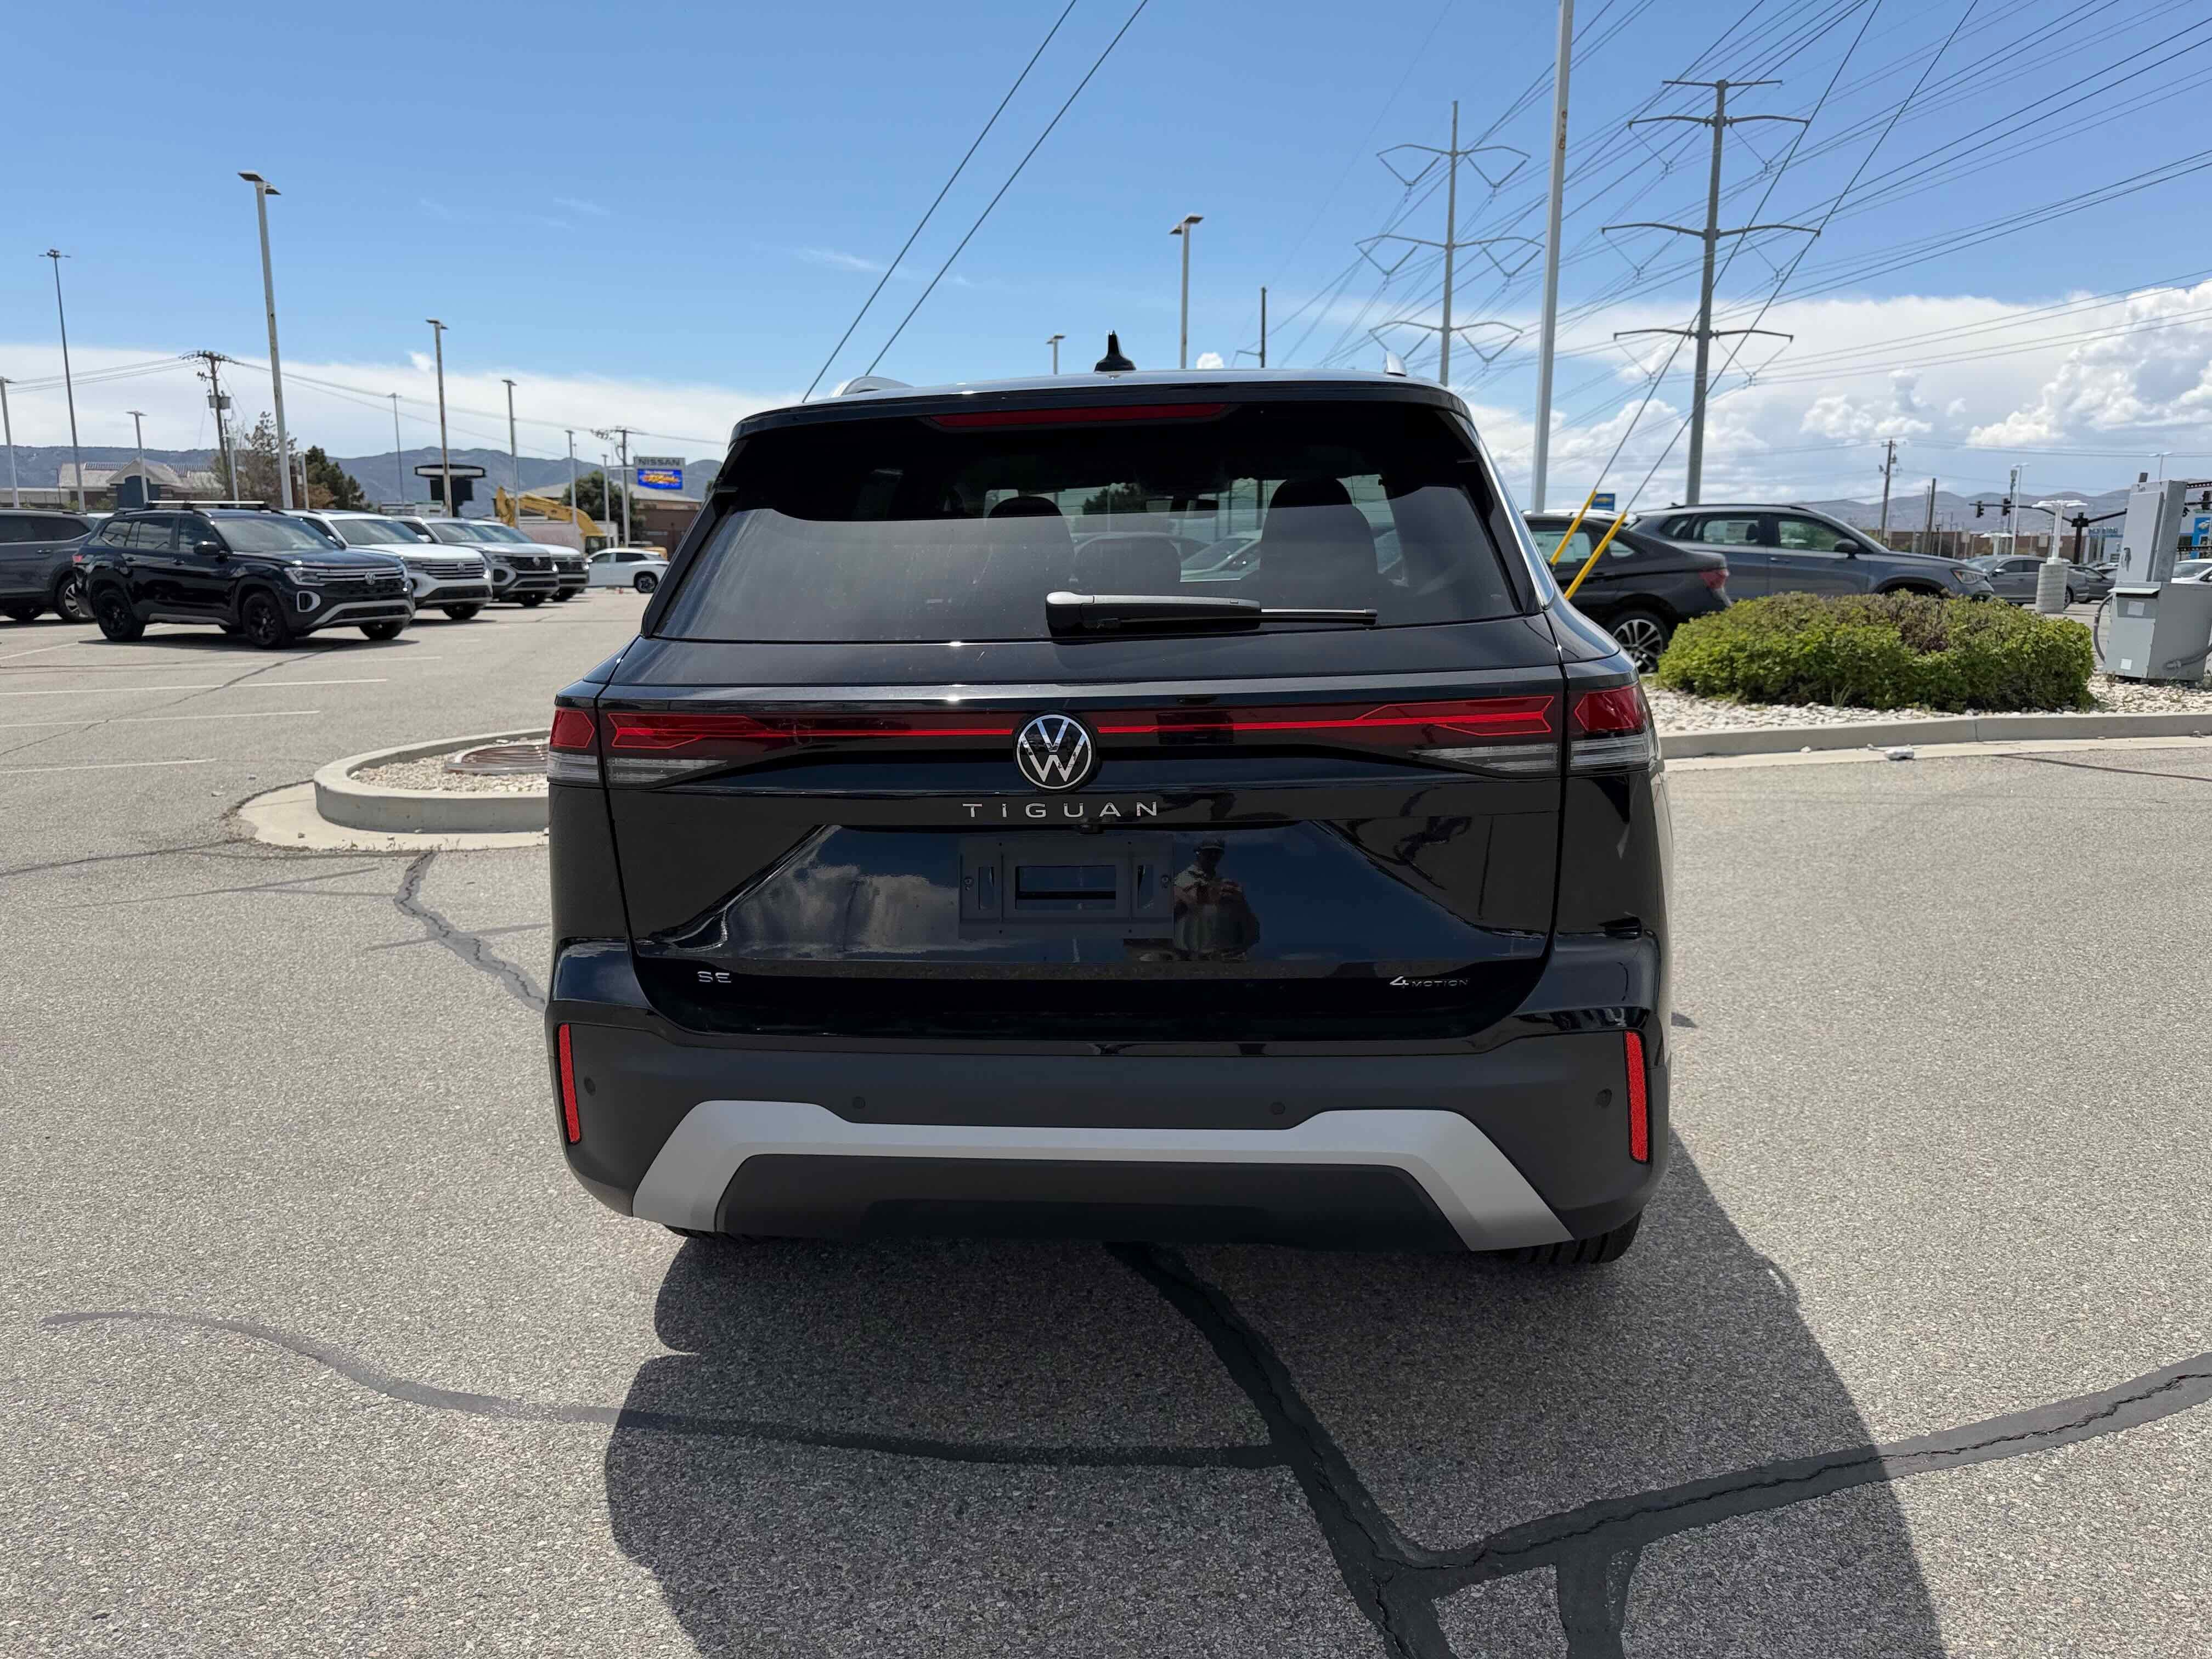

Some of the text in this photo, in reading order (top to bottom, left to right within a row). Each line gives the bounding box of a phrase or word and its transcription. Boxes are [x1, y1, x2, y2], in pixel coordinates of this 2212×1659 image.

[1017, 714, 1092, 789] VW
[962, 802, 1157, 818] TIGUAN
[697, 970, 732, 983] SE
[1389, 975, 1469, 989] 4MOTION
